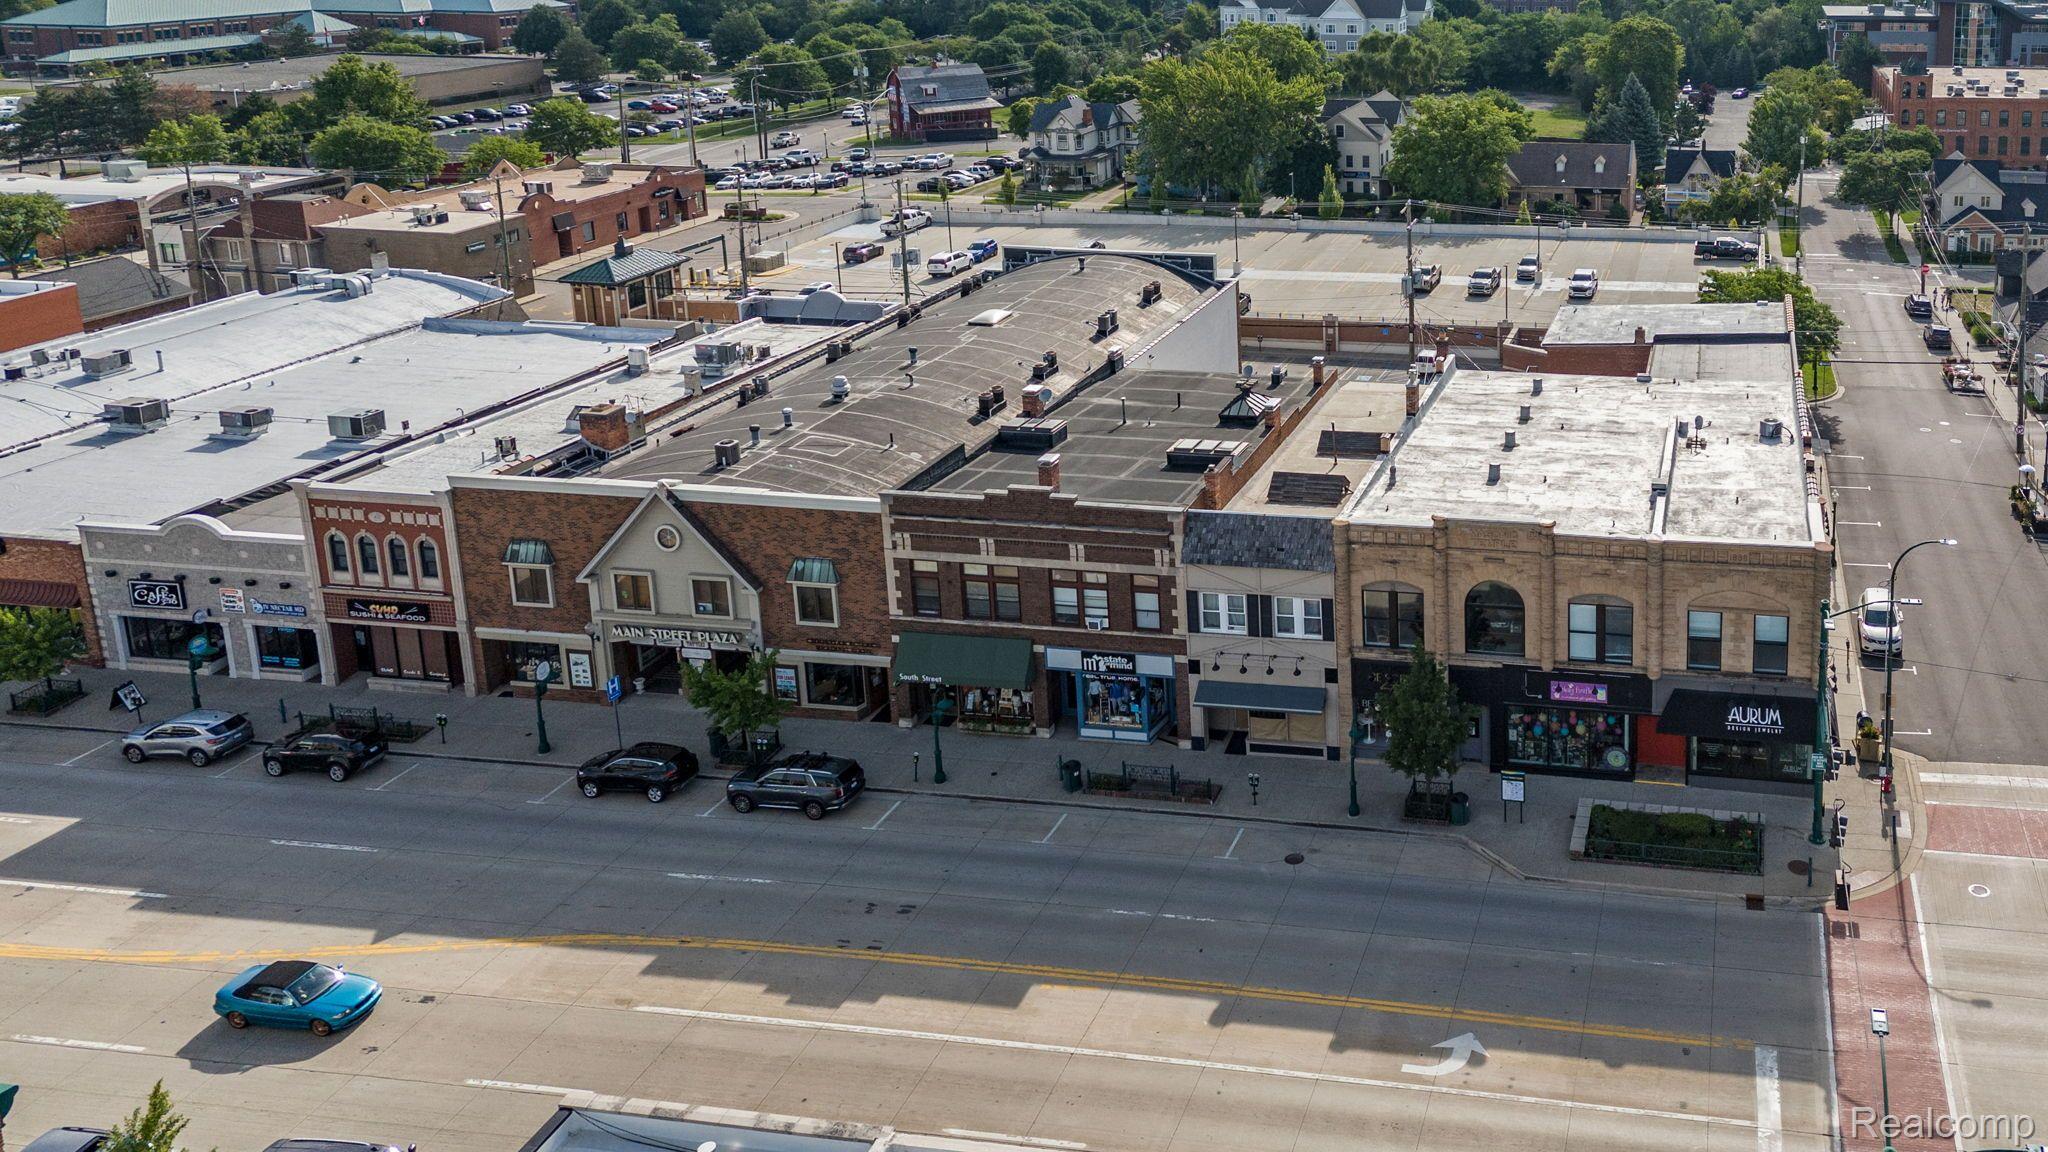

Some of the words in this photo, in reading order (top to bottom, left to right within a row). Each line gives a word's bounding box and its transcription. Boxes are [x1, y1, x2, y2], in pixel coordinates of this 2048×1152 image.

[270, 604, 293, 612] NECTAR
[349, 610, 376, 618] SUSHI
[385, 613, 426, 622] SEAFOOD
[611, 626, 644, 638] MAIN
[649, 628, 692, 642] STREET
[697, 631, 738, 644] PLAZA
[1103, 655, 1128, 664] state
[1110, 662, 1133, 670] mind
[899, 672, 919, 681] South
[921, 674, 942, 683] Street
[608, 677, 619, 694] H
[1727, 706, 1782, 725] AURUM
